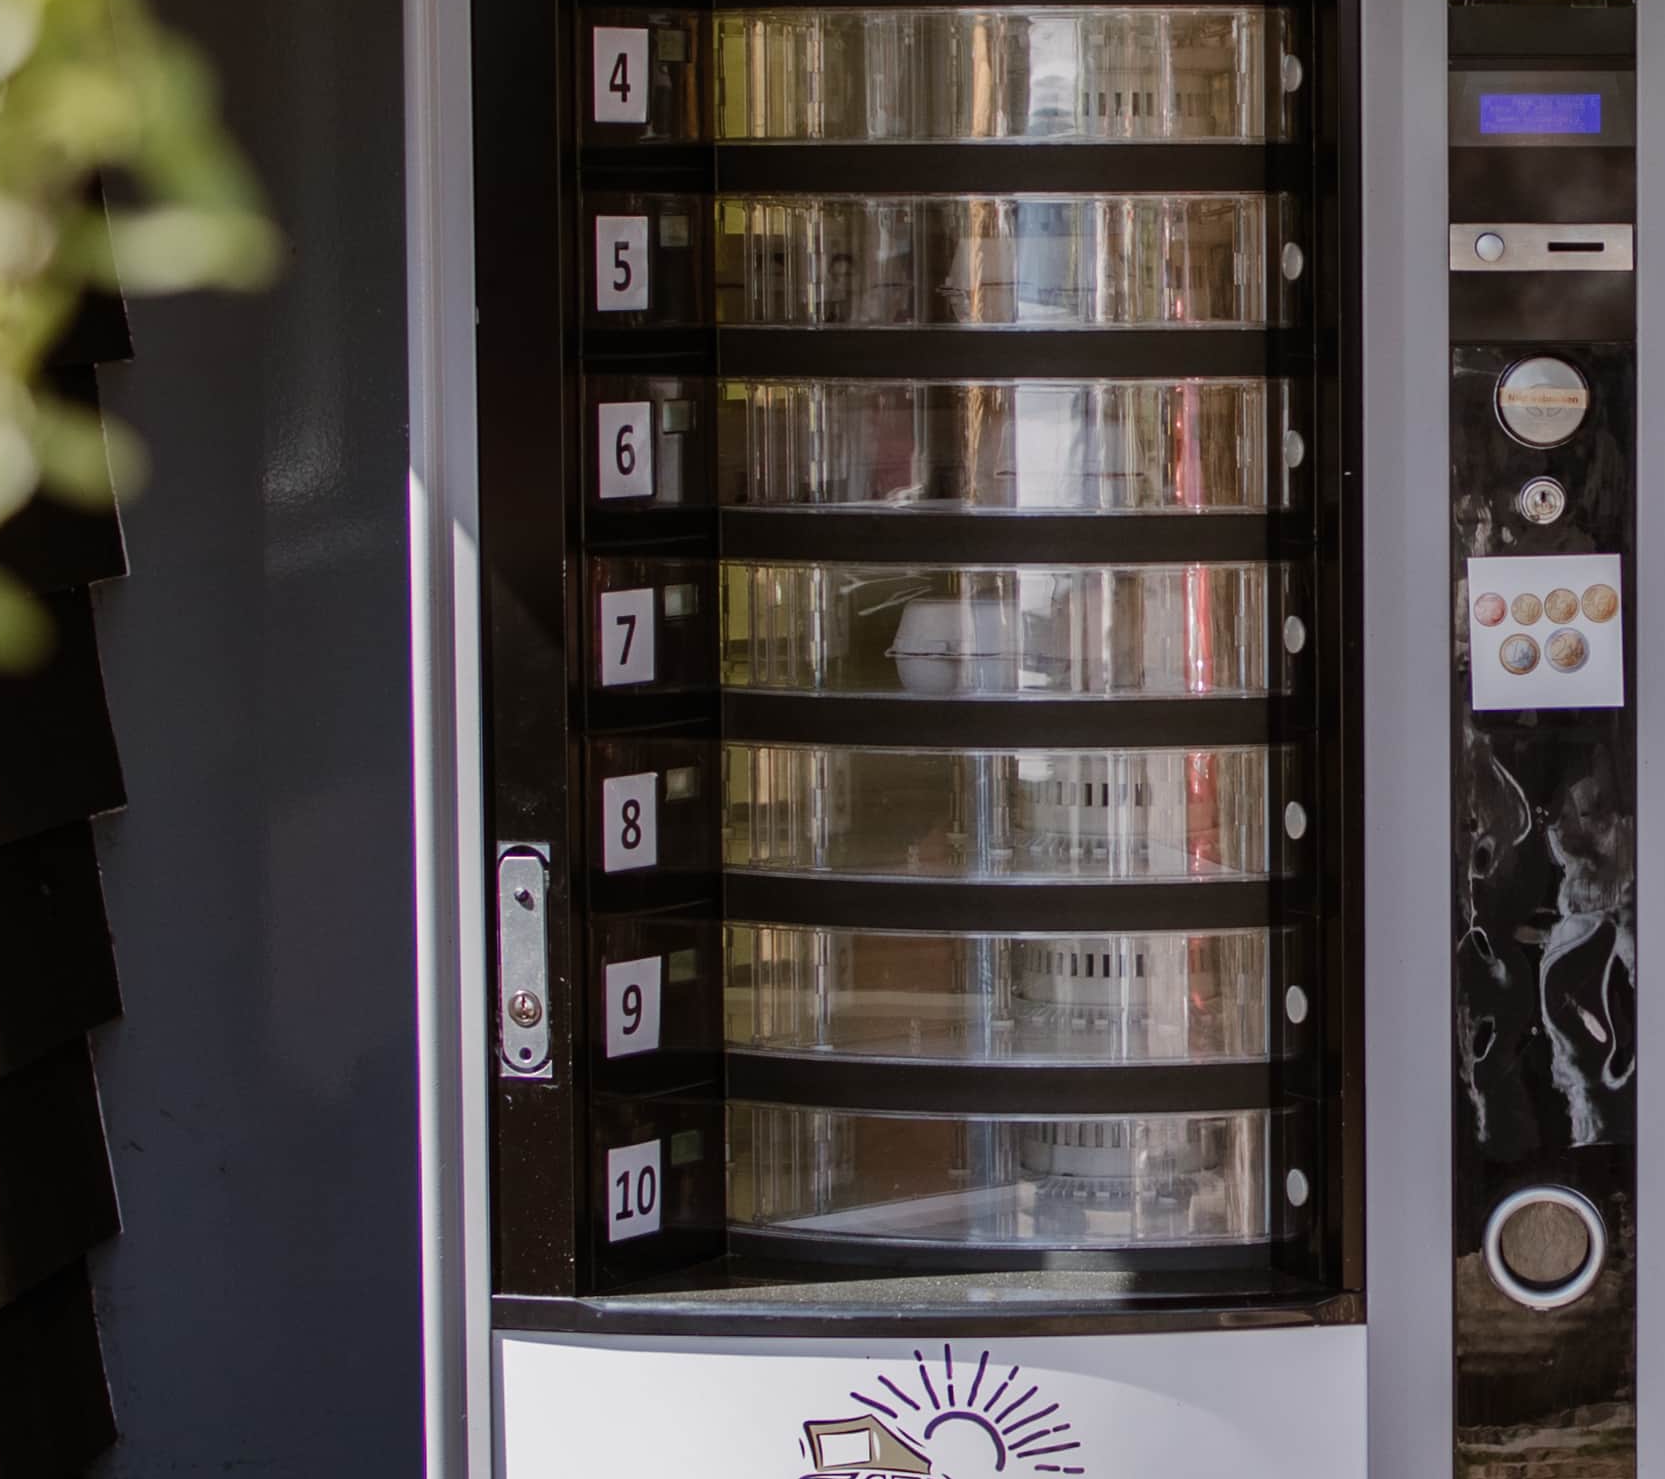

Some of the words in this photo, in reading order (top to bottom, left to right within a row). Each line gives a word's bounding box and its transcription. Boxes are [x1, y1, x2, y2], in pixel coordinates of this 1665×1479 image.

[609, 52, 631, 103] 4
[613, 241, 632, 292] 5
[615, 424, 636, 476] 6
[616, 614, 636, 666] 7
[621, 798, 642, 850] 8
[622, 984, 642, 1036] 9
[615, 1165, 656, 1221] 10
